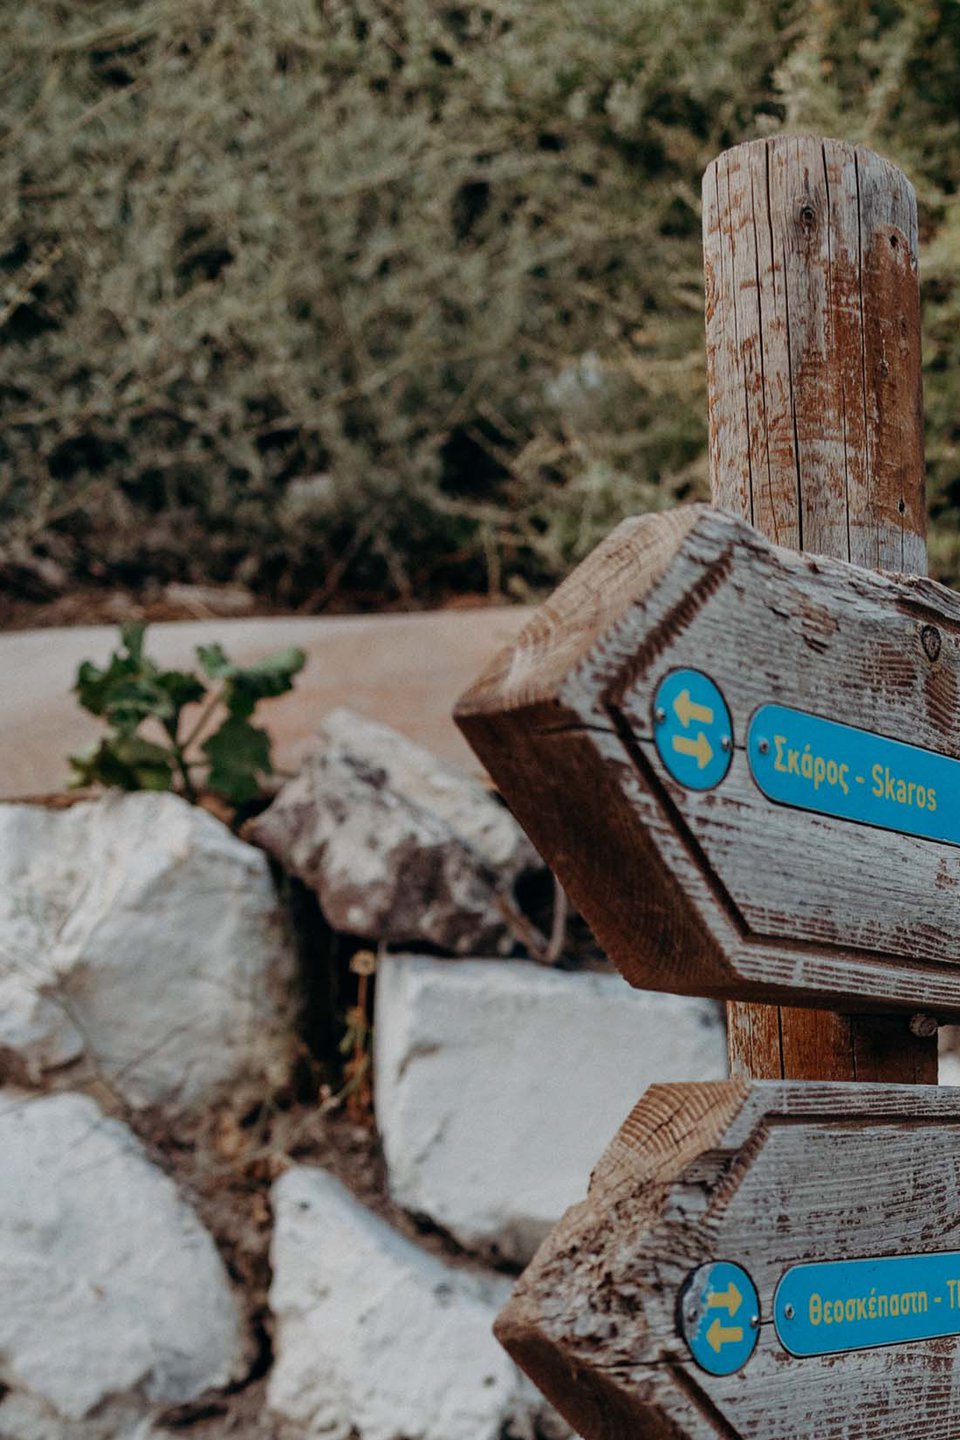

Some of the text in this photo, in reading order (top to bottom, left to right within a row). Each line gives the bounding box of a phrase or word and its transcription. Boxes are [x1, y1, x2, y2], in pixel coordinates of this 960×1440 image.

[773, 734, 850, 796] Σκάρος
[871, 763, 938, 812] Skaros
[808, 1286, 929, 1327] Θεοσκέπαστη
